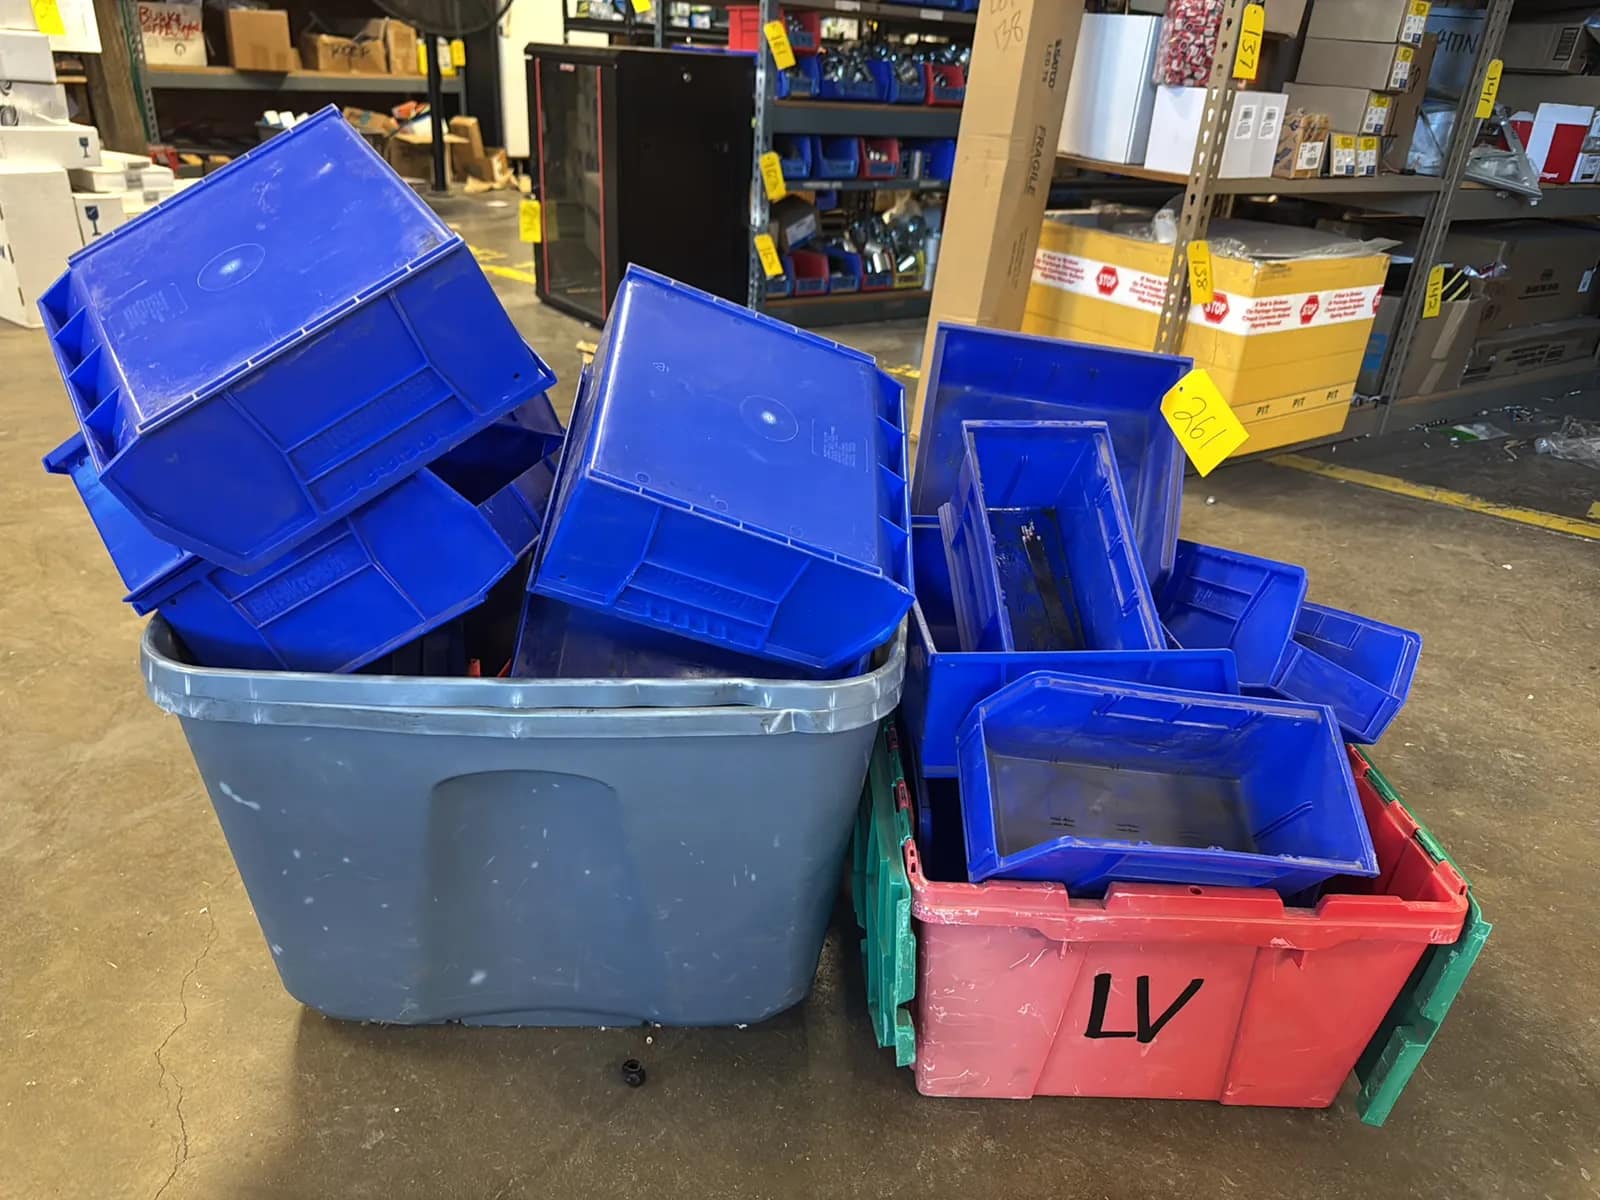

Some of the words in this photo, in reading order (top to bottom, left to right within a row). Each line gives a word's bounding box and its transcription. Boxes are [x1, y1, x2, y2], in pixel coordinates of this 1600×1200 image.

[1239, 29, 1261, 70] 137
[1480, 76, 1497, 104] 141
[1027, 124, 1047, 193] FRAGILE
[1098, 273, 1117, 289] STOP
[1191, 259, 1209, 291] 138
[1255, 404, 1270, 417] PIT
[1291, 396, 1306, 409] PIT
[1326, 389, 1340, 401] PIT
[1172, 396, 1228, 449] 261
[1083, 972, 1205, 1044] LV
